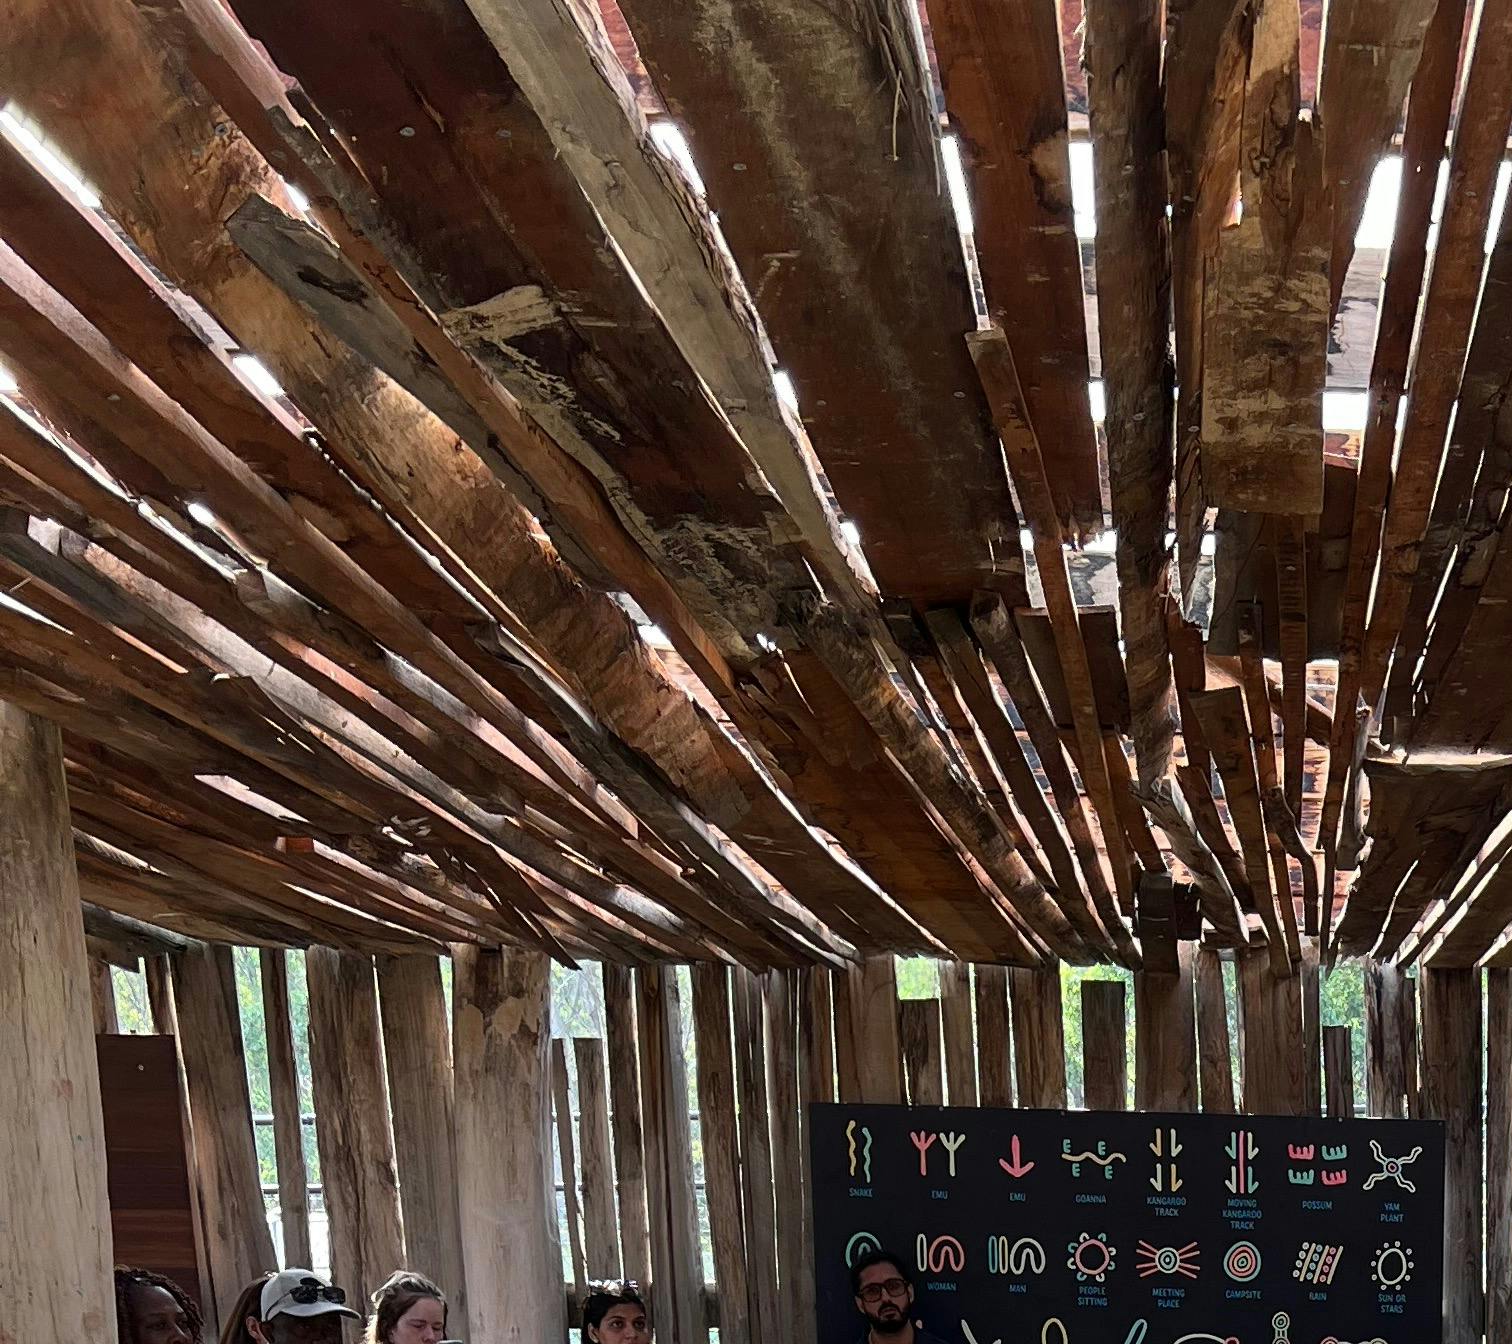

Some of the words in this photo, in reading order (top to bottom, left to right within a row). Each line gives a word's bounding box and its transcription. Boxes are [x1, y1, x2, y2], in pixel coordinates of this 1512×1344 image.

[849, 1188, 873, 1198] SNAKE
[931, 1190, 949, 1200] EMU
[1009, 1192, 1026, 1202] EMU
[1075, 1194, 1107, 1204] GOANNA
[1146, 1197, 1187, 1206] KANGAROO
[1227, 1199, 1257, 1208] MOVING
[1302, 1200, 1333, 1210] POSSUM
[1155, 1207, 1179, 1217] TRACK
[1222, 1210, 1262, 1219] KANGAROO
[1380, 1213, 1404, 1223] PLANT
[1230, 1220, 1255, 1230] TRACK
[927, 1282, 957, 1292] WOMAN
[1009, 1284, 1027, 1293] MAN
[1078, 1286, 1106, 1296] PEOPLE
[1152, 1288, 1185, 1298] MEETING
[1225, 1290, 1262, 1300] CAMPSITE
[1309, 1291, 1327, 1301] RAIN
[1378, 1293, 1392, 1303] SUN
[1394, 1294, 1406, 1303] OR
[1077, 1297, 1108, 1307] SITTING
[1157, 1299, 1180, 1309] PLACE
[1380, 1304, 1403, 1314] STARS
